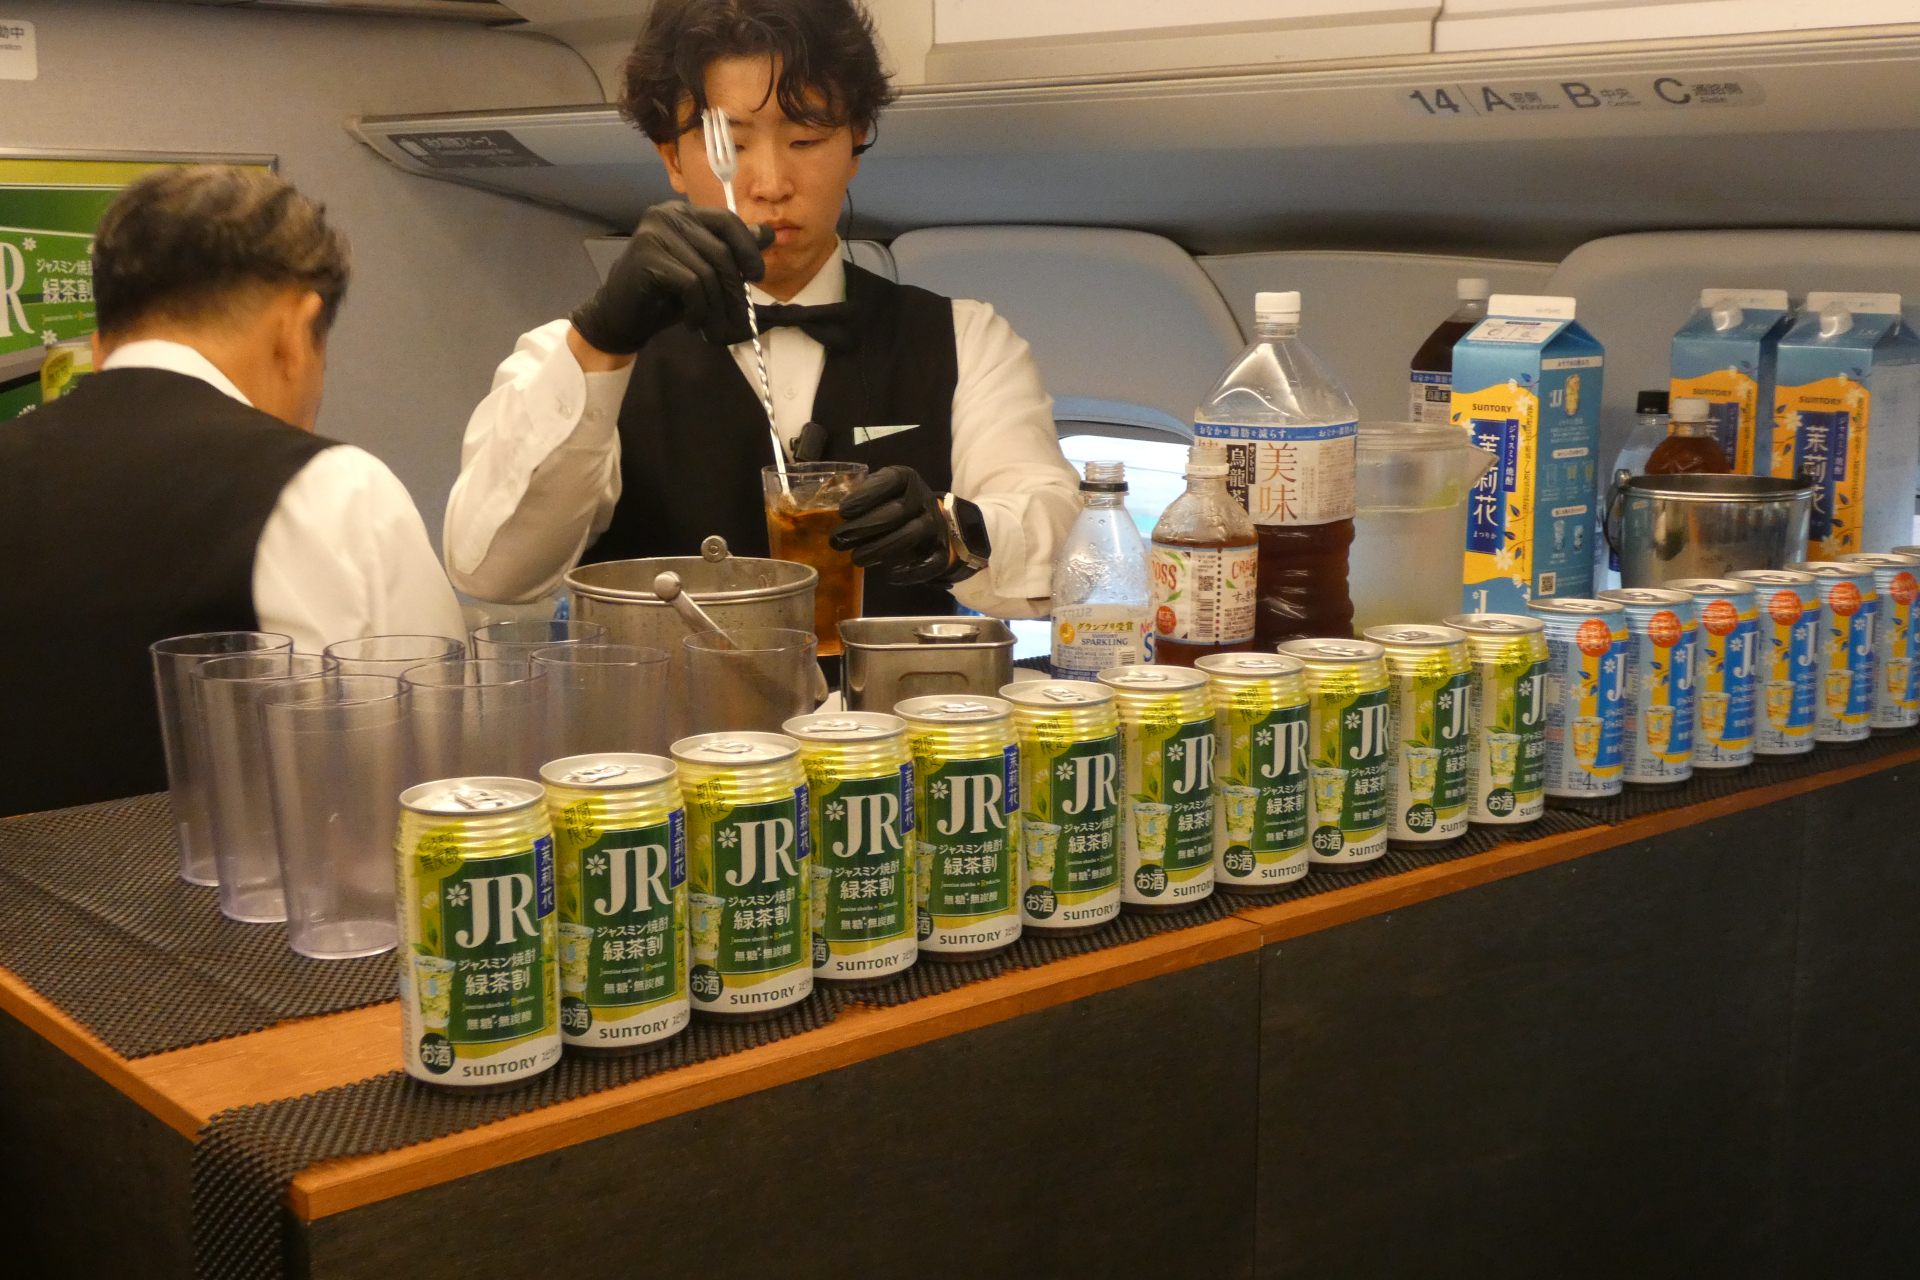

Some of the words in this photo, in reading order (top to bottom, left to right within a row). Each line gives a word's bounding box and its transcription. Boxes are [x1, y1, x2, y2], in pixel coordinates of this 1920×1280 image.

[1409, 88, 1460, 115] 14
[1482, 86, 1516, 112] A
[1561, 82, 1602, 109] B
[1653, 77, 1691, 104] C
[1472, 403, 1512, 414] SUNTORY
[1799, 396, 1843, 406] SUNTORY
[1259, 442, 1298, 523] 美味
[1076, 621, 1134, 632] グランプリ受賞
[1081, 638, 1128, 646] SPARKLING
[1350, 703, 1390, 760] JR
[1261, 720, 1309, 778] JR
[1173, 733, 1216, 794] JR
[1062, 753, 1118, 815] JR
[936, 774, 1007, 835] JR
[1488, 795, 1514, 811] お酒
[832, 793, 903, 858] JR
[1407, 811, 1434, 828] お酒
[725, 818, 798, 887] JR
[938, 839, 1003, 855] ジャスミン焼酎
[1068, 830, 1113, 854] 緑茶割
[1313, 833, 1342, 850] お酒
[943, 854, 998, 876] 緑茶割
[1225, 854, 1253, 872] お酒
[594, 844, 672, 916] JR
[839, 876, 895, 900] 緑茶割
[1136, 872, 1165, 890] お酒
[728, 886, 796, 907] ジャスミン焼酎
[1026, 893, 1055, 913] お酒
[455, 873, 540, 948] JR
[733, 903, 791, 931] 緑茶割
[1063, 905, 1114, 921] SUNTORY
[597, 915, 669, 938] ジャスミン焼酎
[939, 931, 1001, 945] SUNTORY
[602, 933, 664, 962] 緑茶割
[813, 943, 828, 962] 酒
[836, 955, 899, 971] SUNTORY
[465, 967, 531, 996] 緑茶割
[691, 974, 720, 997] お酒
[730, 986, 795, 1005] SUNTORY
[560, 1007, 589, 1030] お酒
[599, 1019, 668, 1039] SUNTORY
[420, 1043, 452, 1068] お酒
[463, 1056, 536, 1077] SUNTORY
